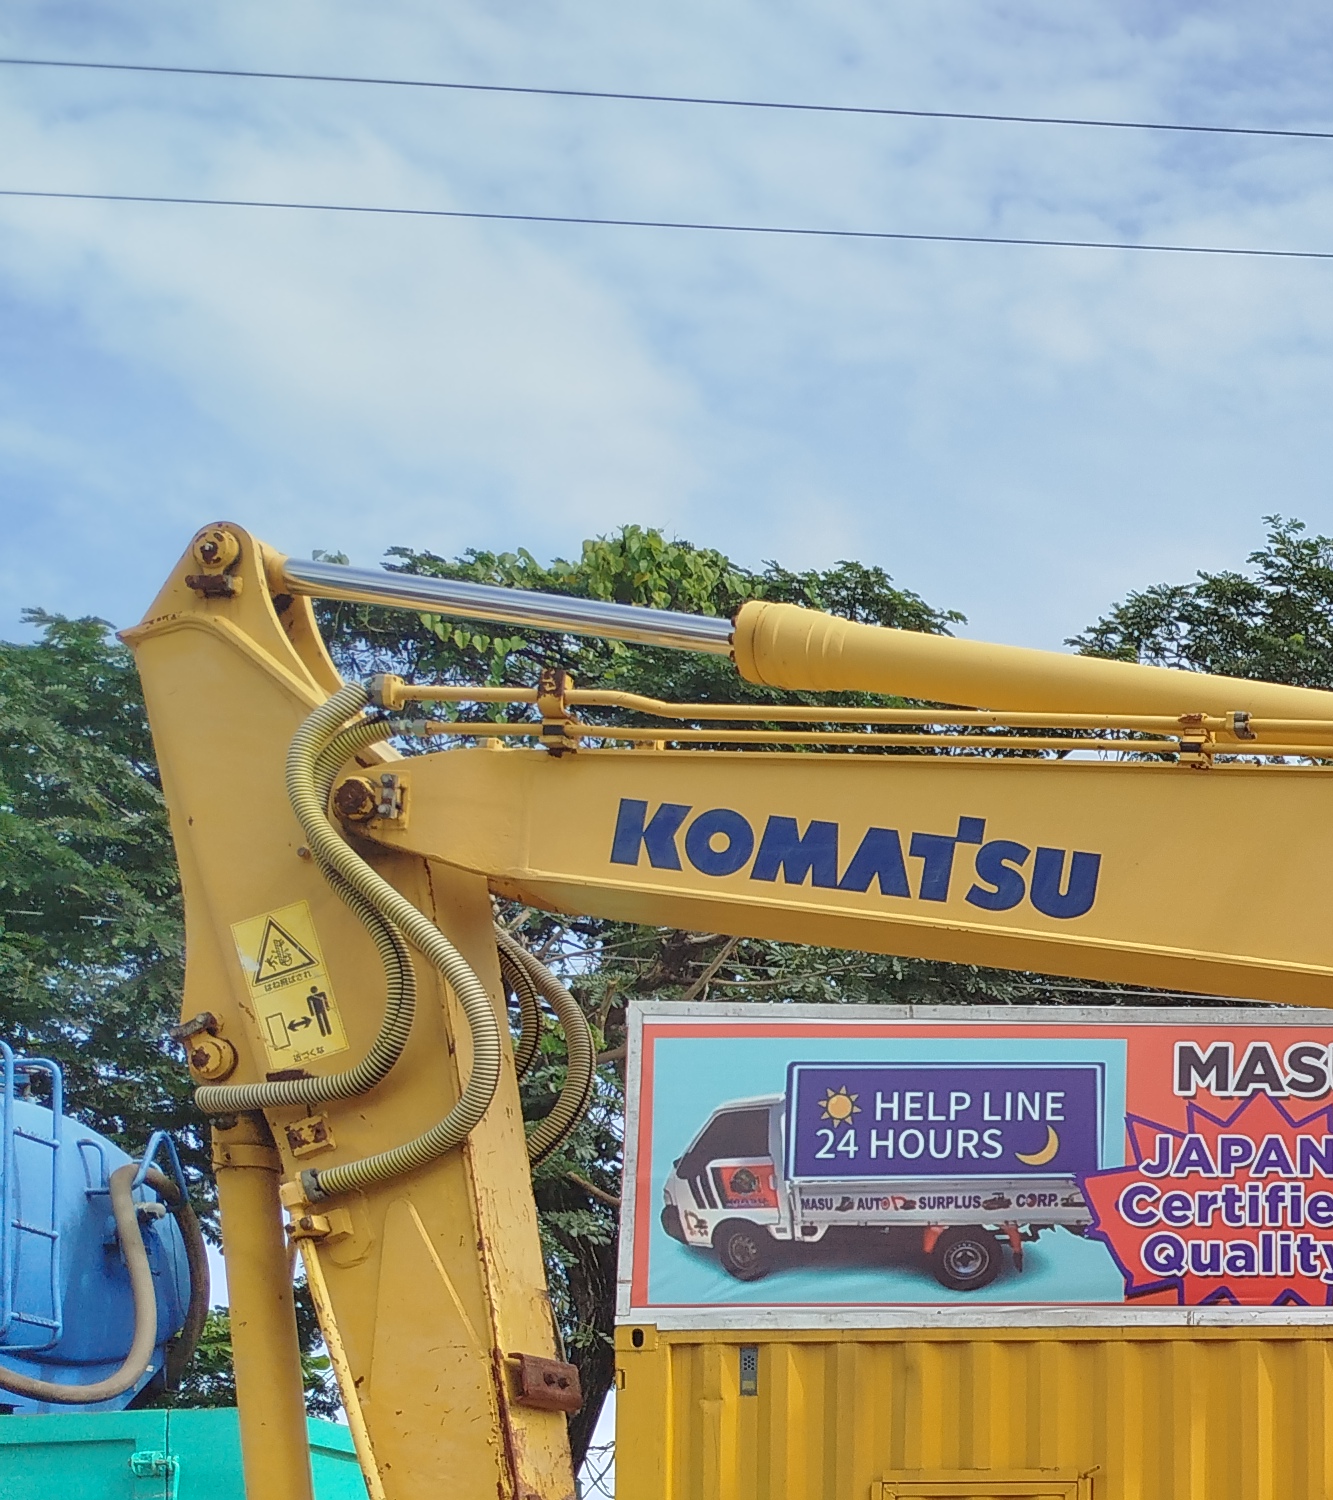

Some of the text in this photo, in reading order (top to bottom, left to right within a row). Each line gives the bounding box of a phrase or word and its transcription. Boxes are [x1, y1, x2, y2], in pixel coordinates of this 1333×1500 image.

[609, 797, 1102, 920] KOMATSU
[875, 1091, 1065, 1121] HELP LINE
[815, 1128, 1003, 1159] 24 HOURS
[801, 1194, 1059, 1211] MASU AUTO SURPLUS CORP.
